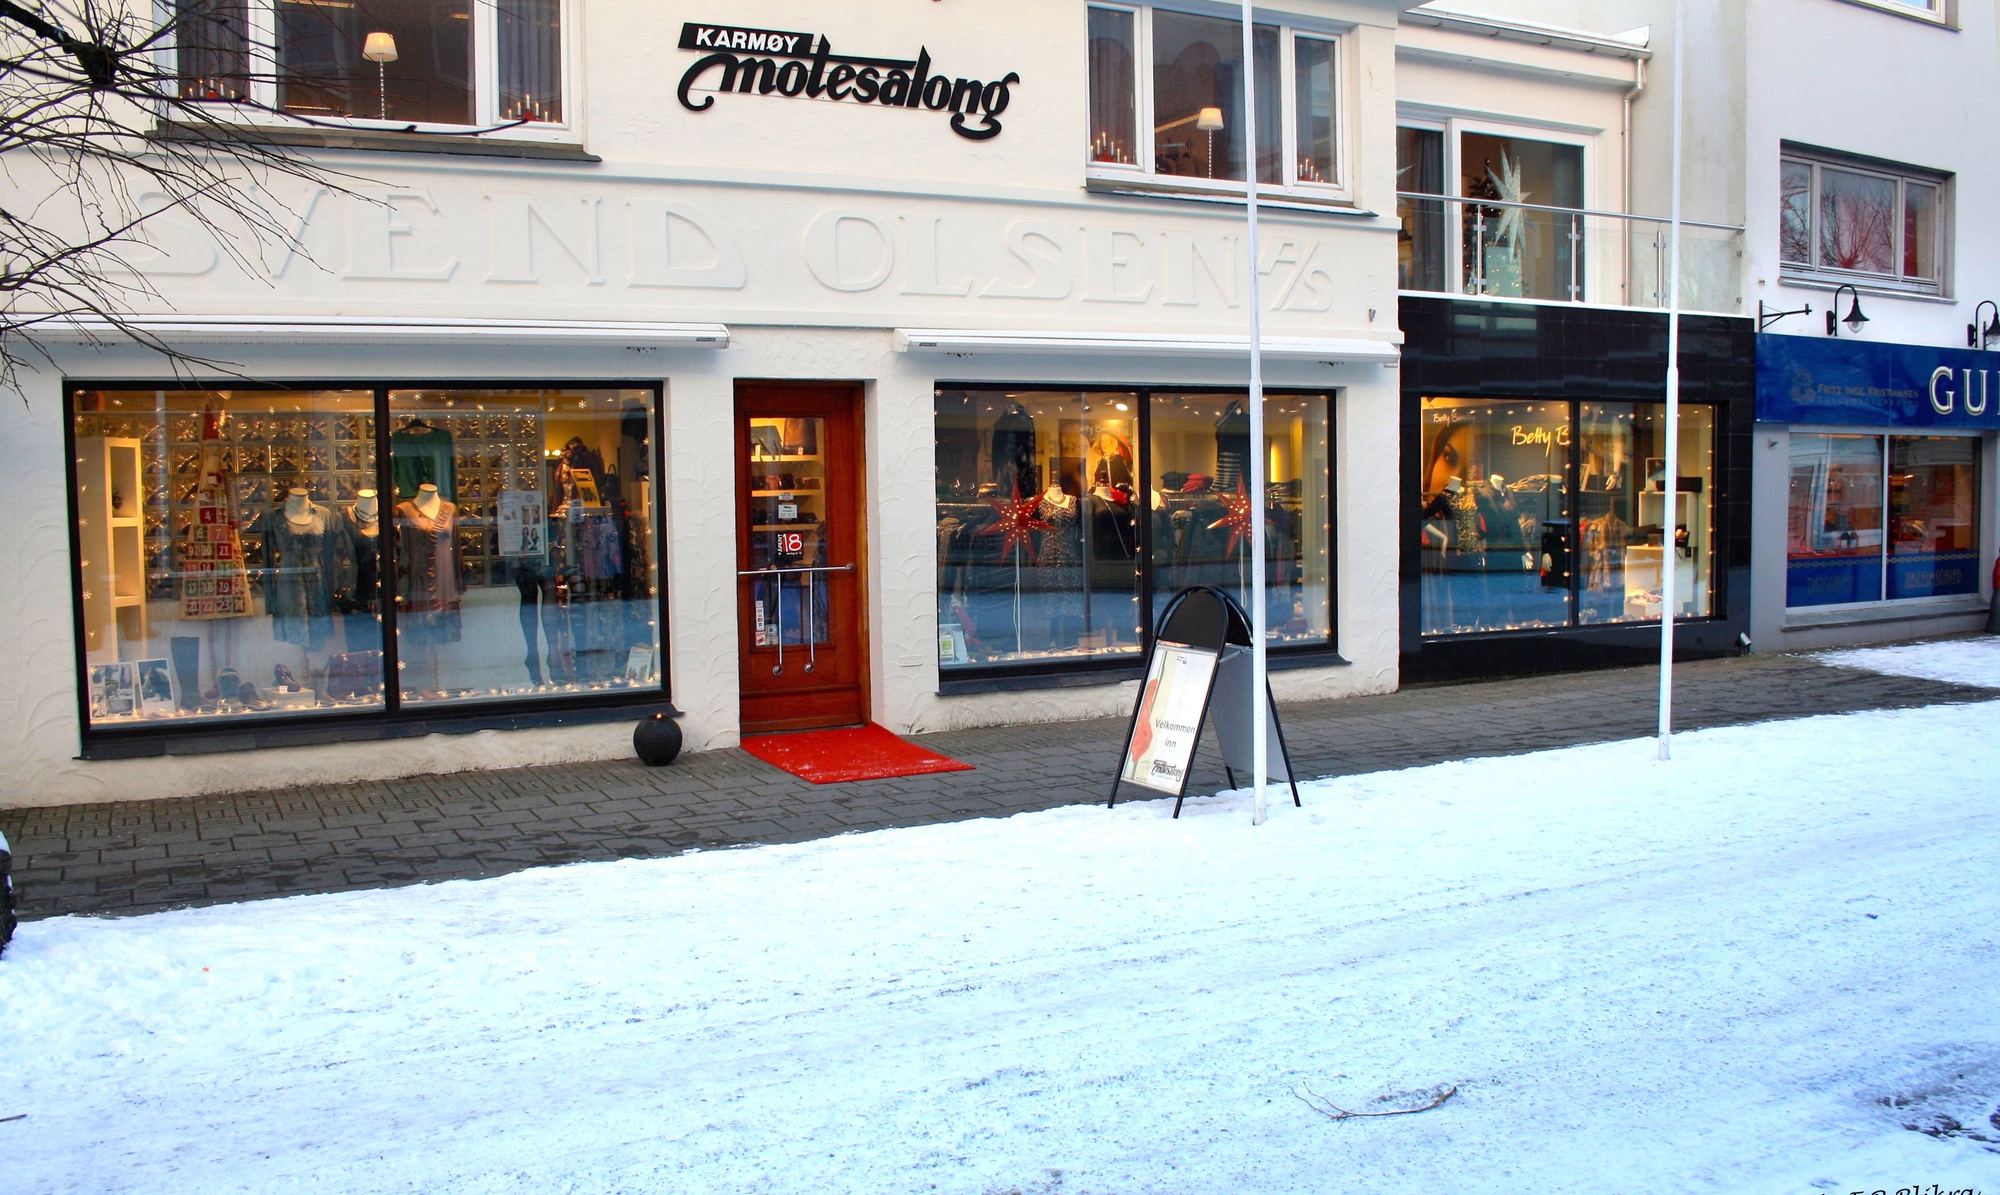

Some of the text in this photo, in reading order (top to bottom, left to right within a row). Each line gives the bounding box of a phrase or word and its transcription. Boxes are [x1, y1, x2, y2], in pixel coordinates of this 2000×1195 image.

[696, 28, 799, 53] KARMØY
[86, 177, 748, 288] SVEND
[803, 208, 1240, 310] OLSEN
[1929, 365, 2000, 417] GU
[1511, 425, 1551, 457] Betty
[782, 533, 802, 552] 18
[1155, 719, 1196, 734] Velkommen
[1164, 738, 1177, 748] inn
